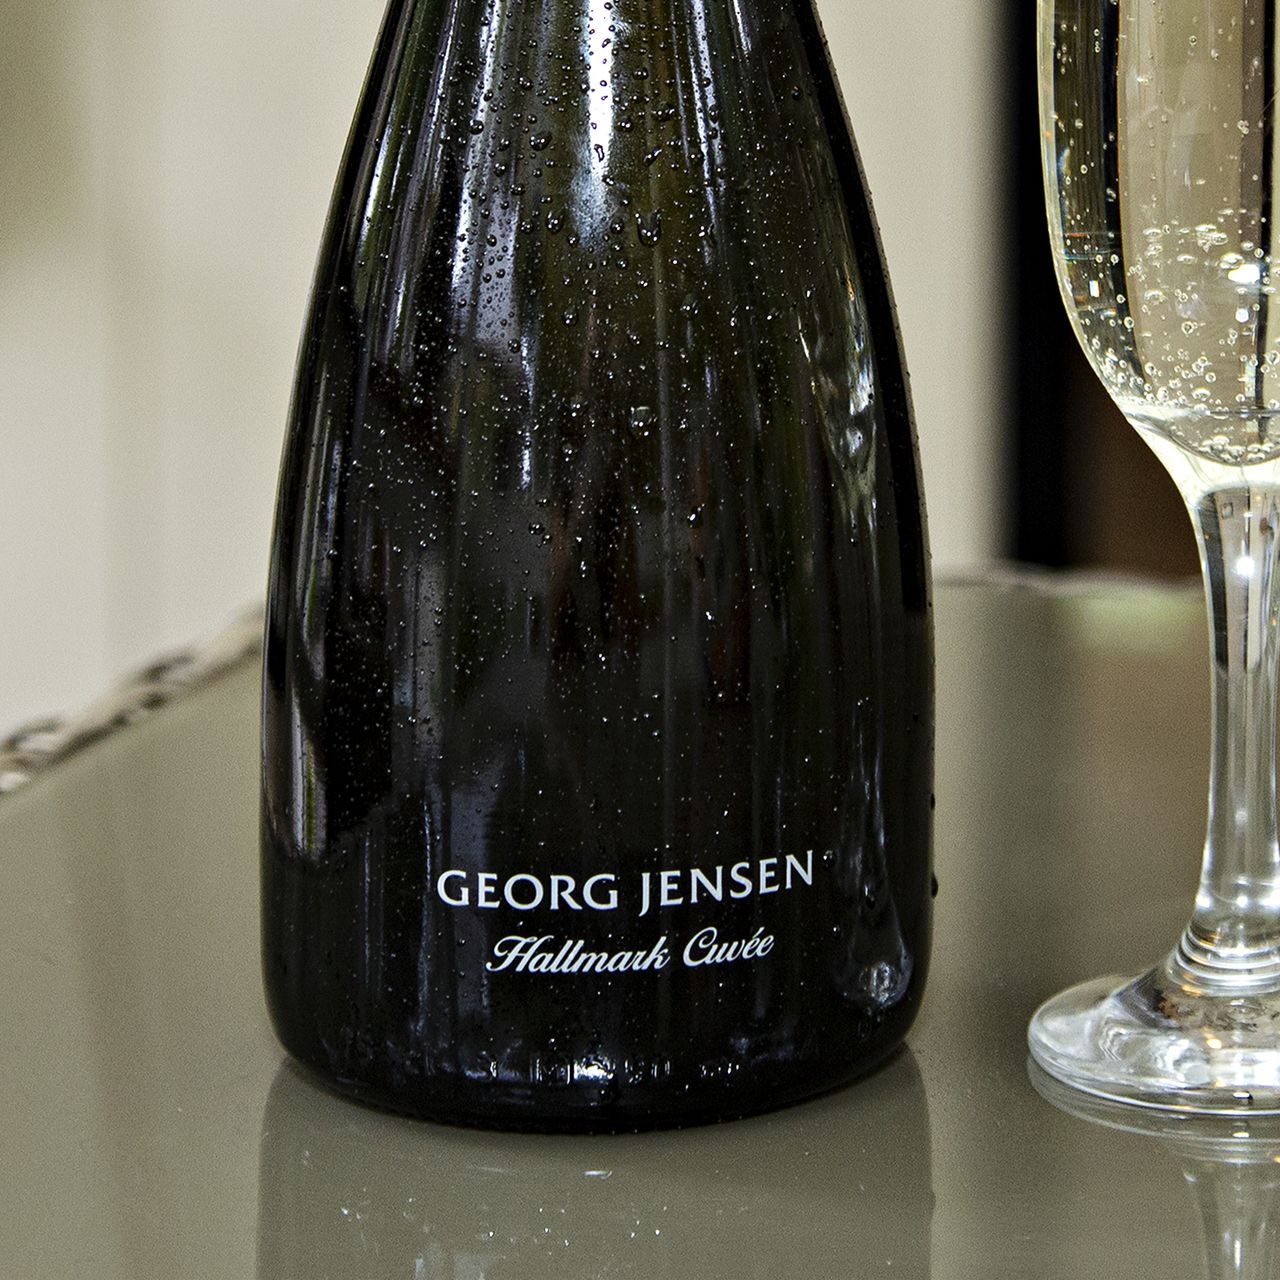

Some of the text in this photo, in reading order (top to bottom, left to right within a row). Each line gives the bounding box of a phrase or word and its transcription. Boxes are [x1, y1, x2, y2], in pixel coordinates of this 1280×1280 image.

[436, 849, 815, 917] GEORG JENSEN
[485, 926, 775, 973] Hallmark Cuvée
